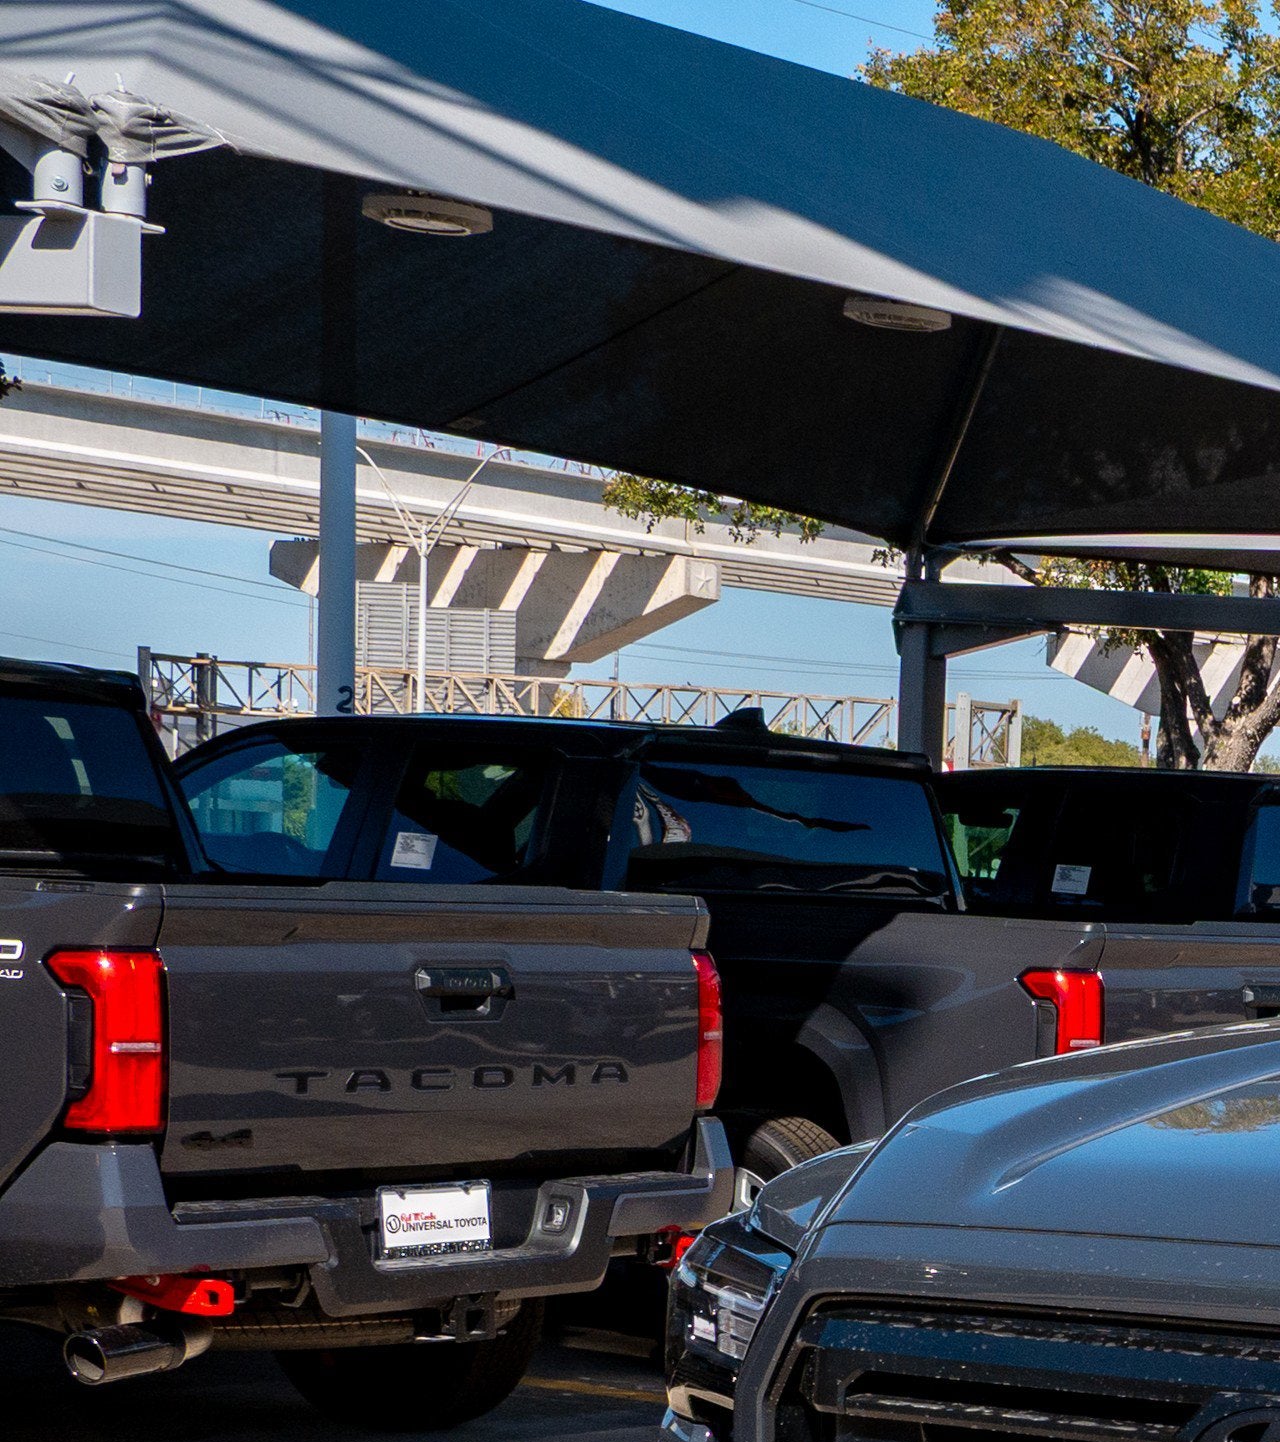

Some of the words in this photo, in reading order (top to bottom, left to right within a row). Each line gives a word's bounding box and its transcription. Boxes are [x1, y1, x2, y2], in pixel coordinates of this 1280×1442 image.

[336, 685, 353, 713] 2
[274, 1061, 630, 1095] TACOMA
[401, 1220, 453, 1233] UNIVERSAL
[454, 1216, 488, 1228] TOYOTA
